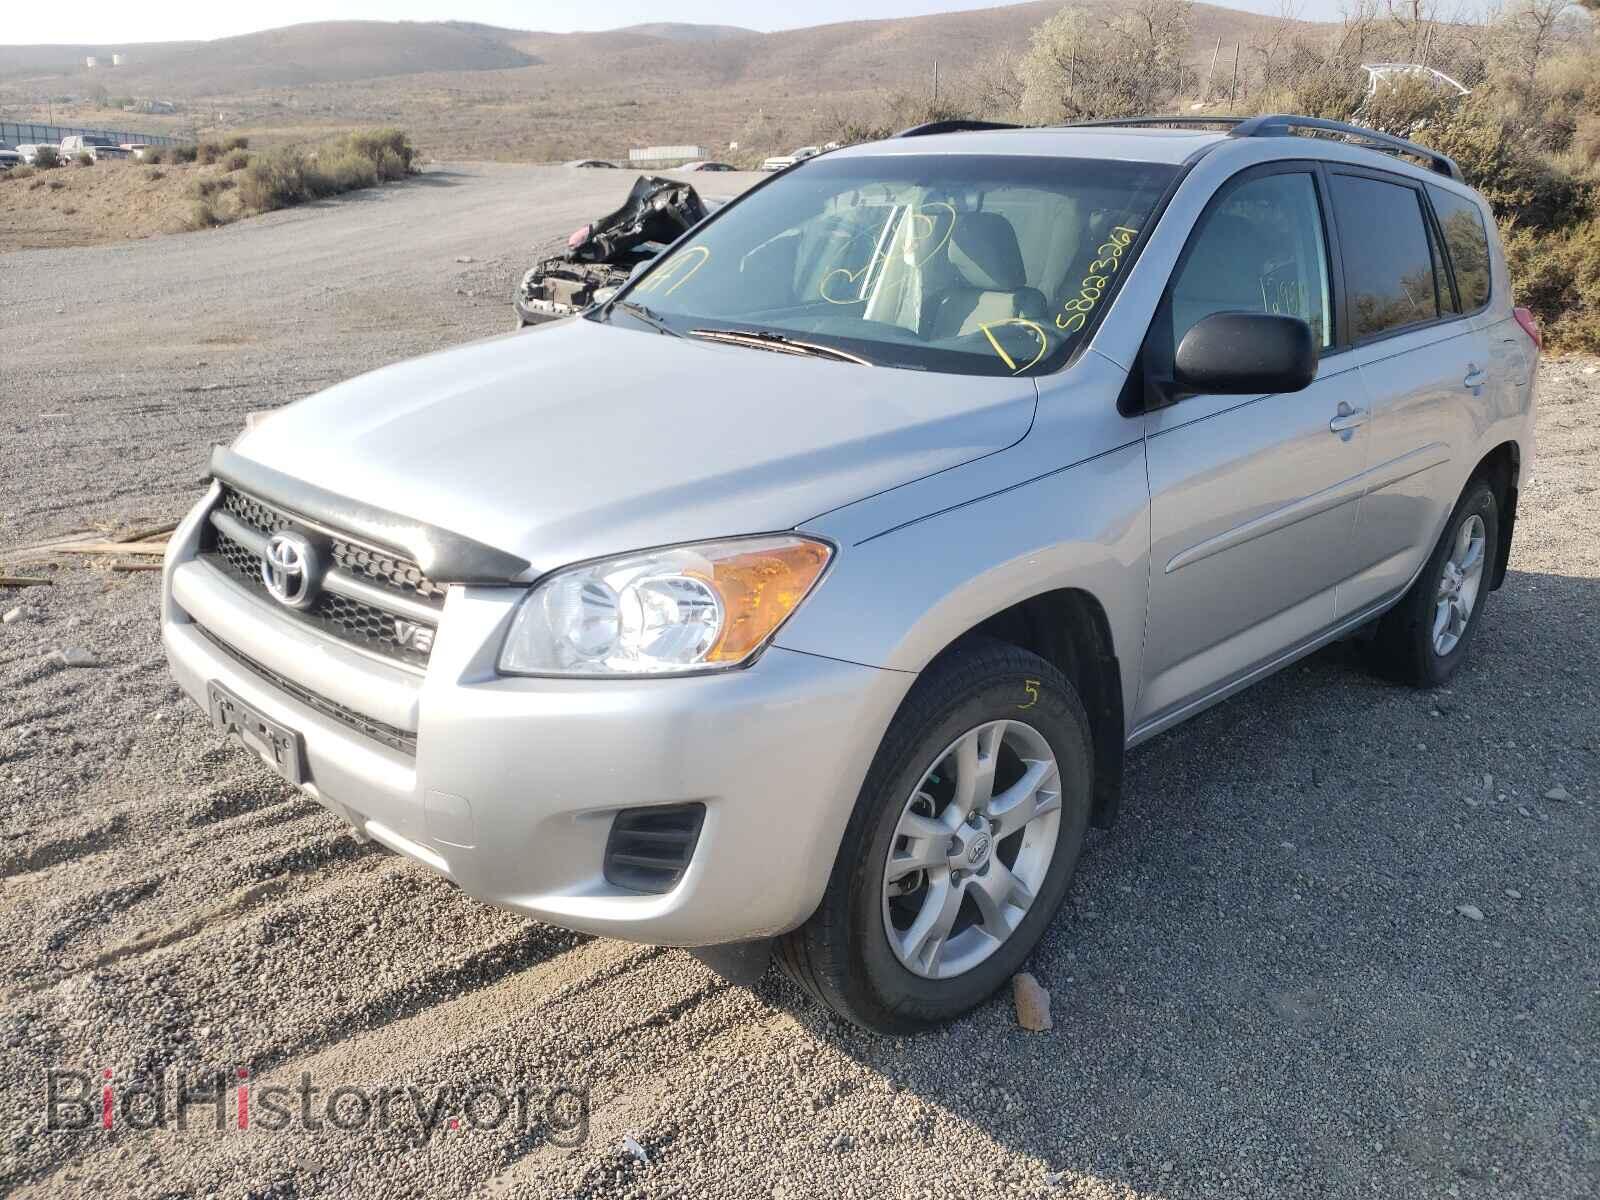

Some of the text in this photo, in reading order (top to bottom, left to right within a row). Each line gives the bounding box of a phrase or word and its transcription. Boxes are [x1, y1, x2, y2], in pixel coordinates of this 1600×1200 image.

[1055, 226, 1139, 333] 58023261
[394, 619, 434, 655] V6
[1015, 679, 1041, 710] 5
